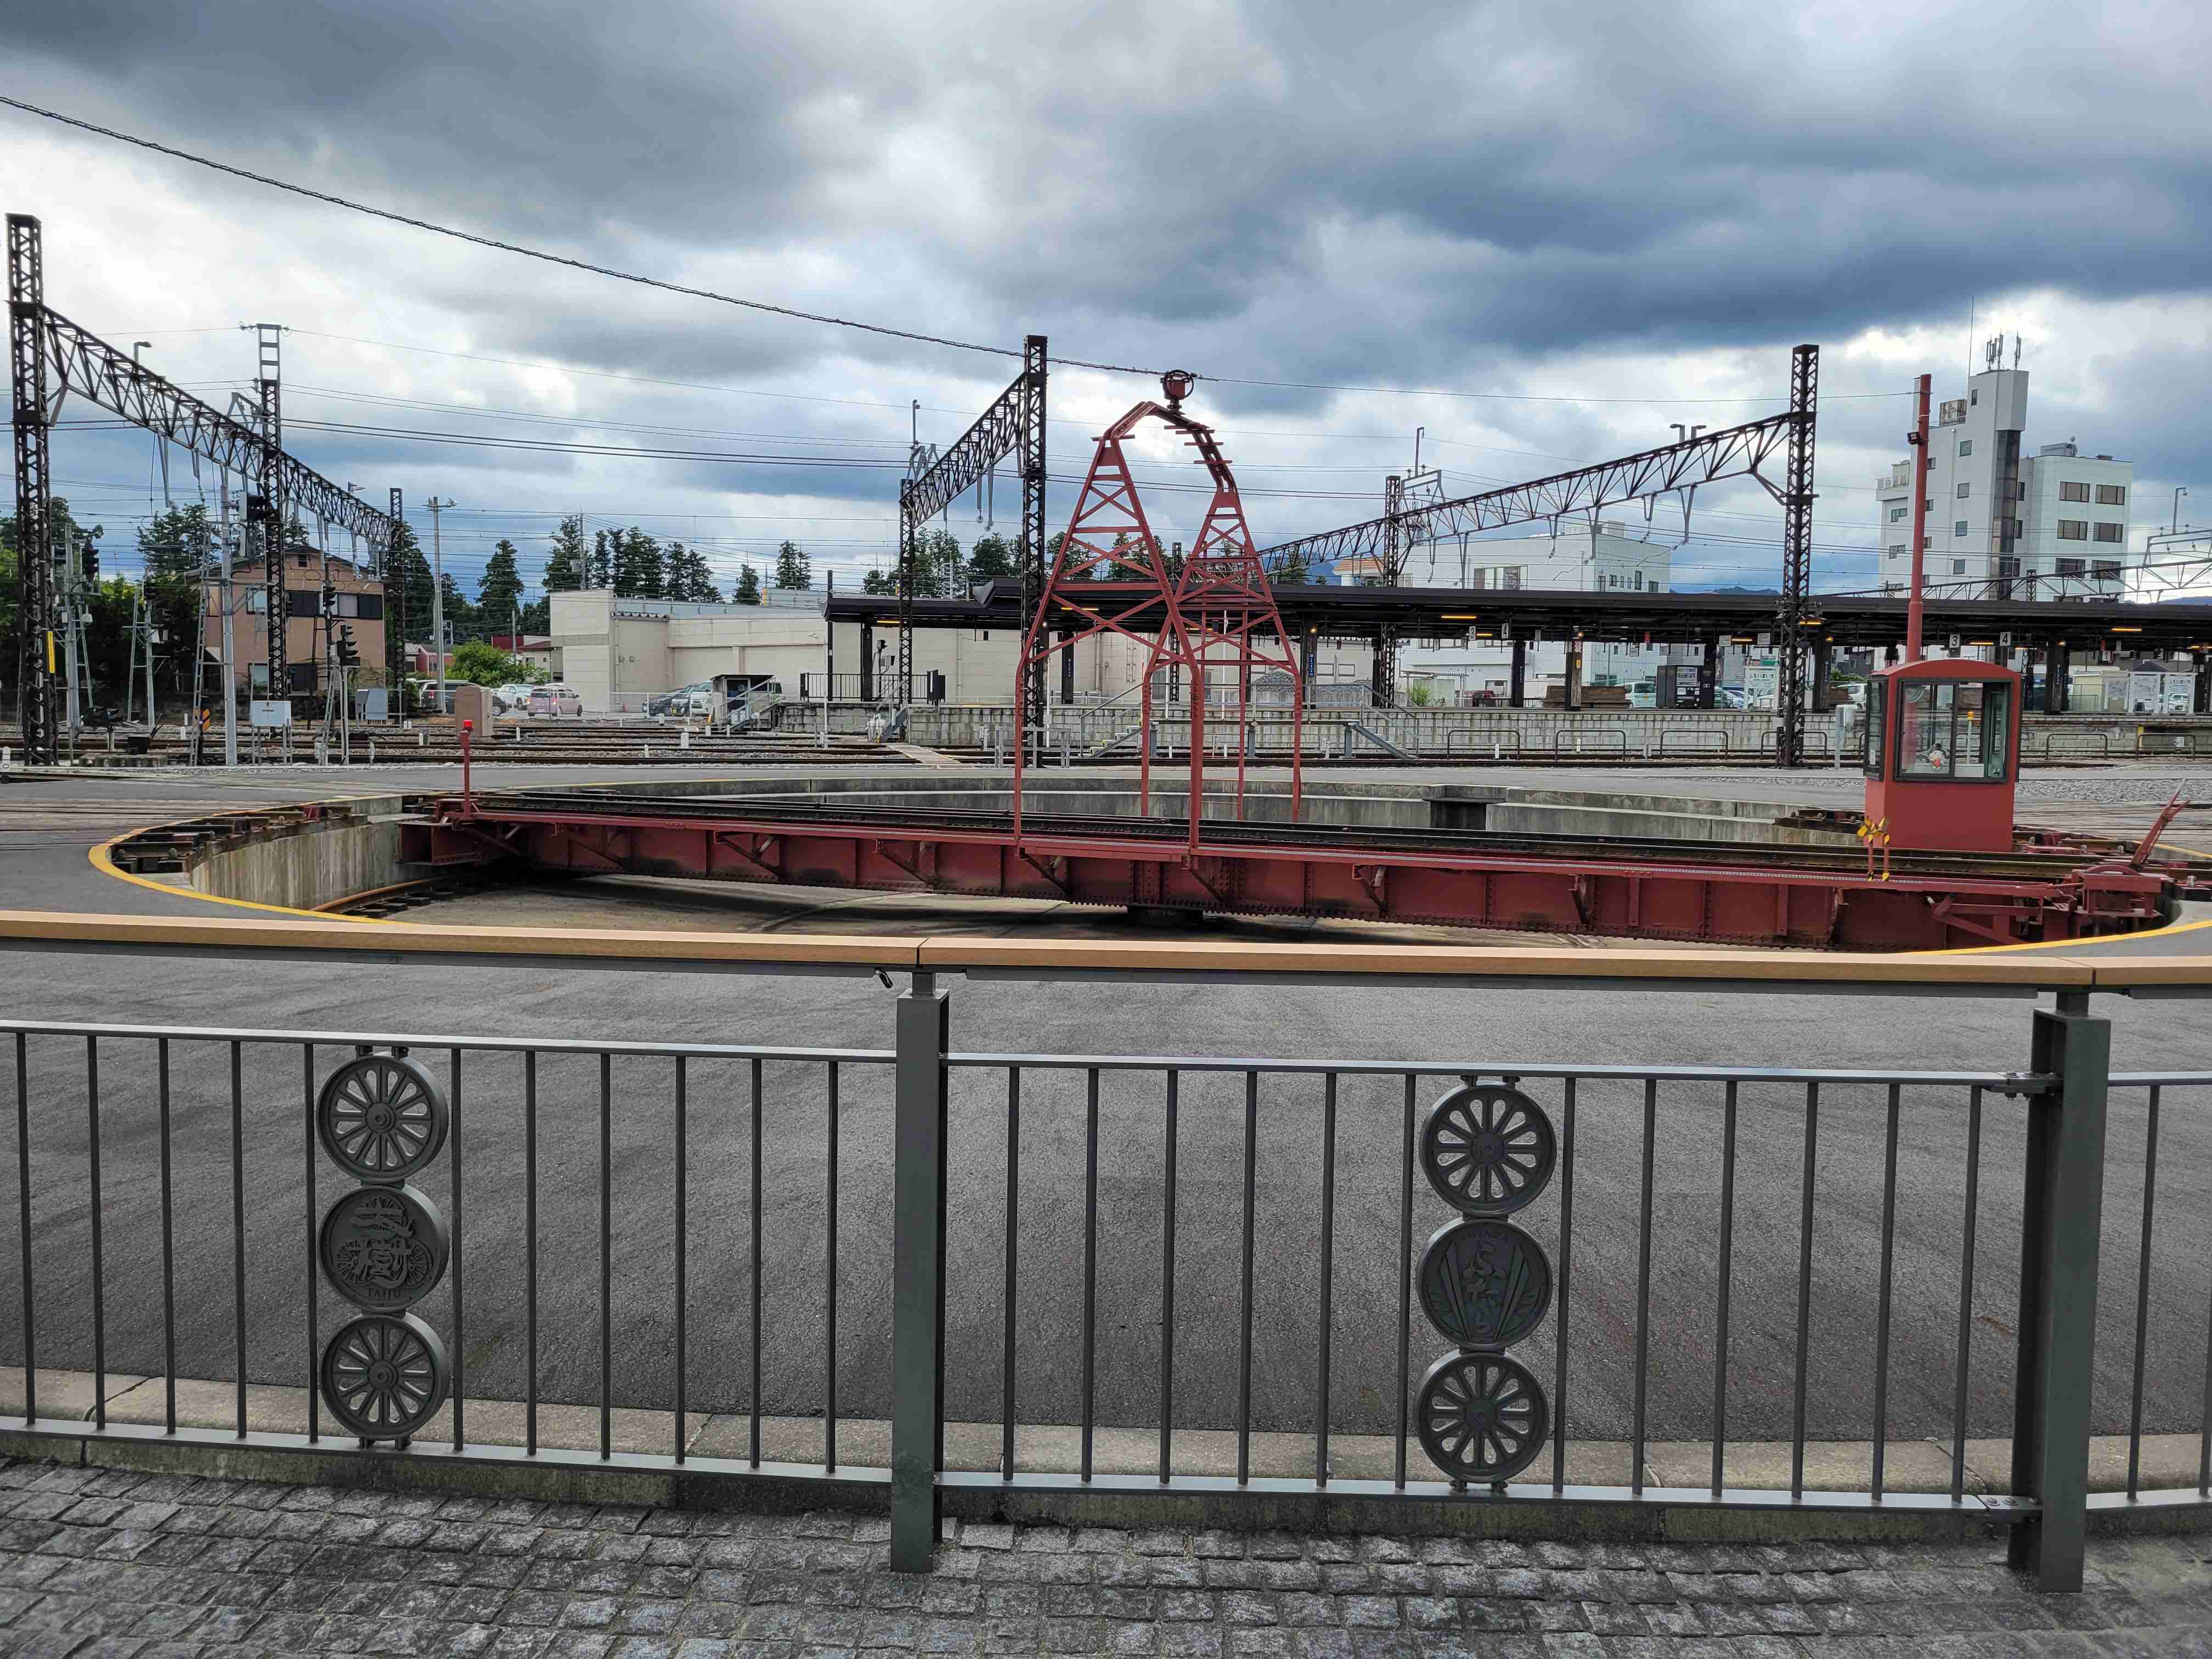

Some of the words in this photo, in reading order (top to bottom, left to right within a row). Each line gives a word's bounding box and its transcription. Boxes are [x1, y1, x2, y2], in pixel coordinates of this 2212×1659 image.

[1470, 627, 1475, 639] 3
[2002, 633, 2008, 644] 4
[1461, 637, 1466, 647] 2
[1952, 635, 1958, 646] 3
[368, 1289, 402, 1300] TAIJU
